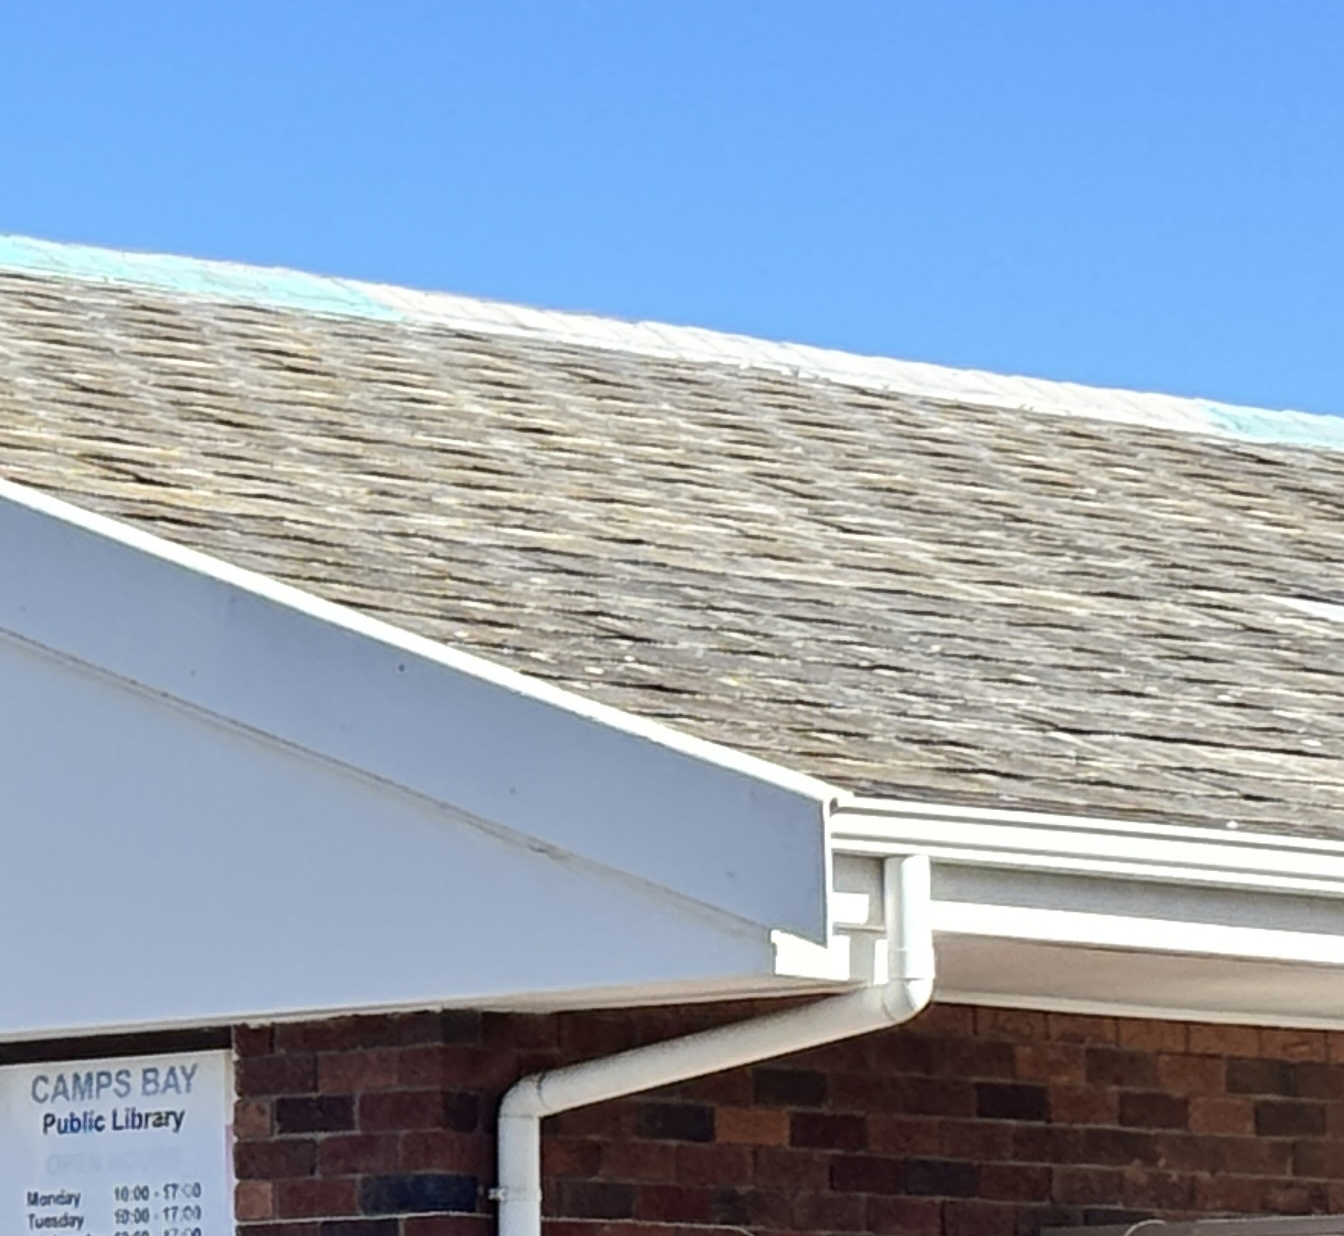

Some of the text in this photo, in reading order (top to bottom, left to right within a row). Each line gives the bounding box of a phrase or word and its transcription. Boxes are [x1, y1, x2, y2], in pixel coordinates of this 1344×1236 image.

[31, 1063, 198, 1104] CAMPS BAY
[42, 1107, 185, 1136] Public Library
[27, 1189, 81, 1208] Monday
[28, 1212, 84, 1231] Tuesday
